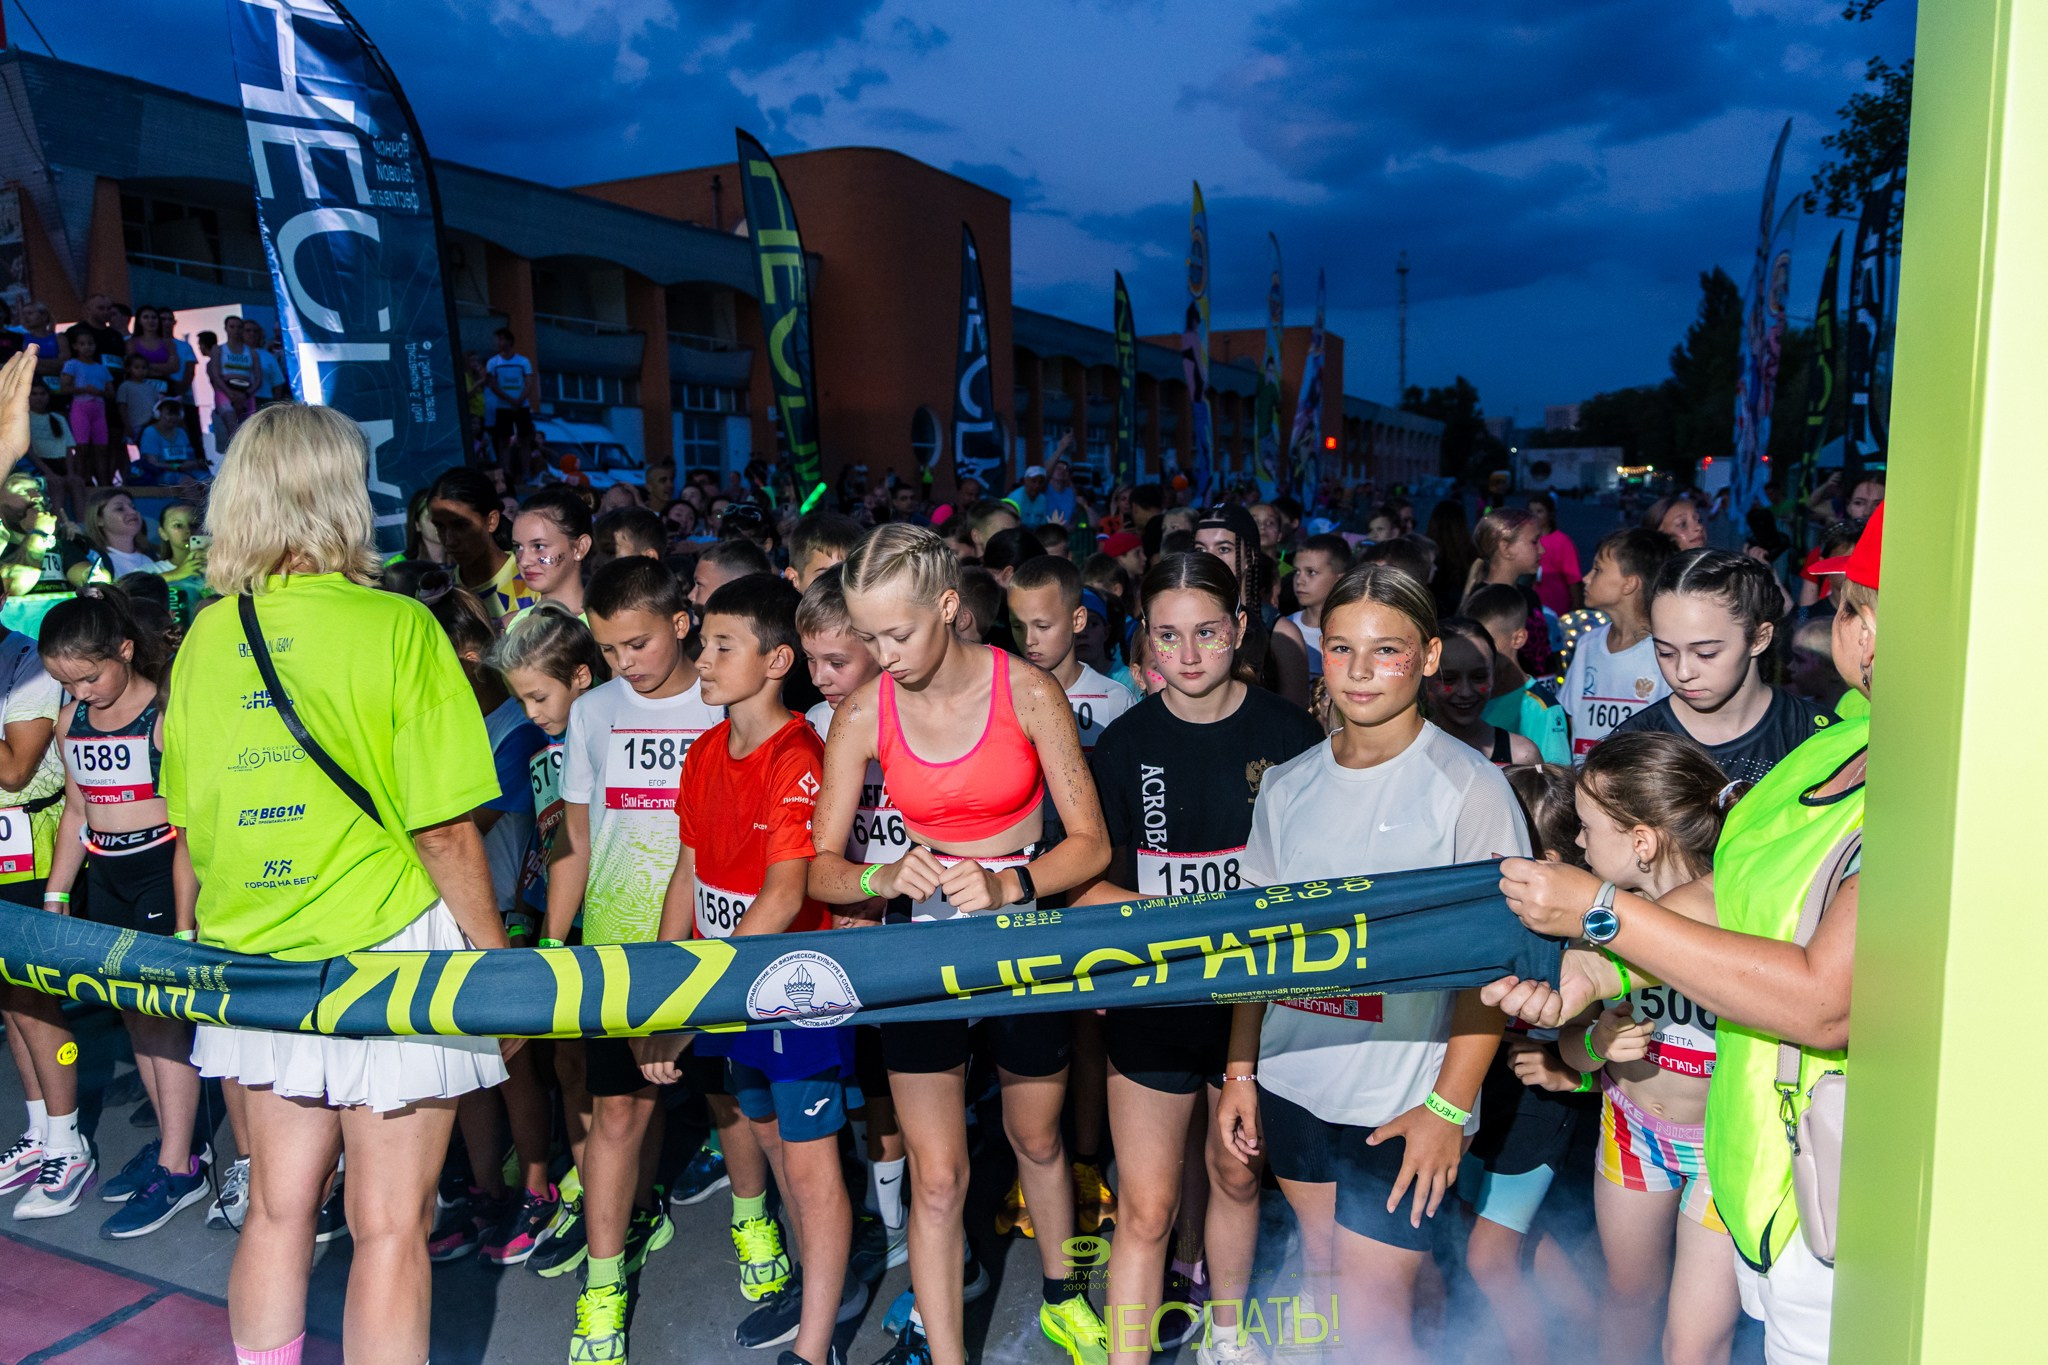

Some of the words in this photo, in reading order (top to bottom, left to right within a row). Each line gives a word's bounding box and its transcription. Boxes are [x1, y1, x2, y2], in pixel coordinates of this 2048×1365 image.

[73, 744, 131, 771] 1589
[648, 779, 667, 787] ЕГОР
[260, 804, 306, 819] BEG1N
[92, 831, 147, 846] NIKE
[245, 880, 277, 889] ГОРОД
[277, 879, 292, 887] НА
[294, 874, 319, 886] БЕГУ
[1158, 858, 1241, 896] 1508
[748, 970, 770, 1008] УПРАВЛЕНИЕ
[769, 963, 778, 972] ПО
[778, 953, 817, 966] ФИЗИЧЕСКОЙ
[816, 955, 840, 975] КУЛЬТУРЕ
[841, 978, 857, 1002] СПОРТУ
[1608, 1087, 1644, 1123] NIKE
